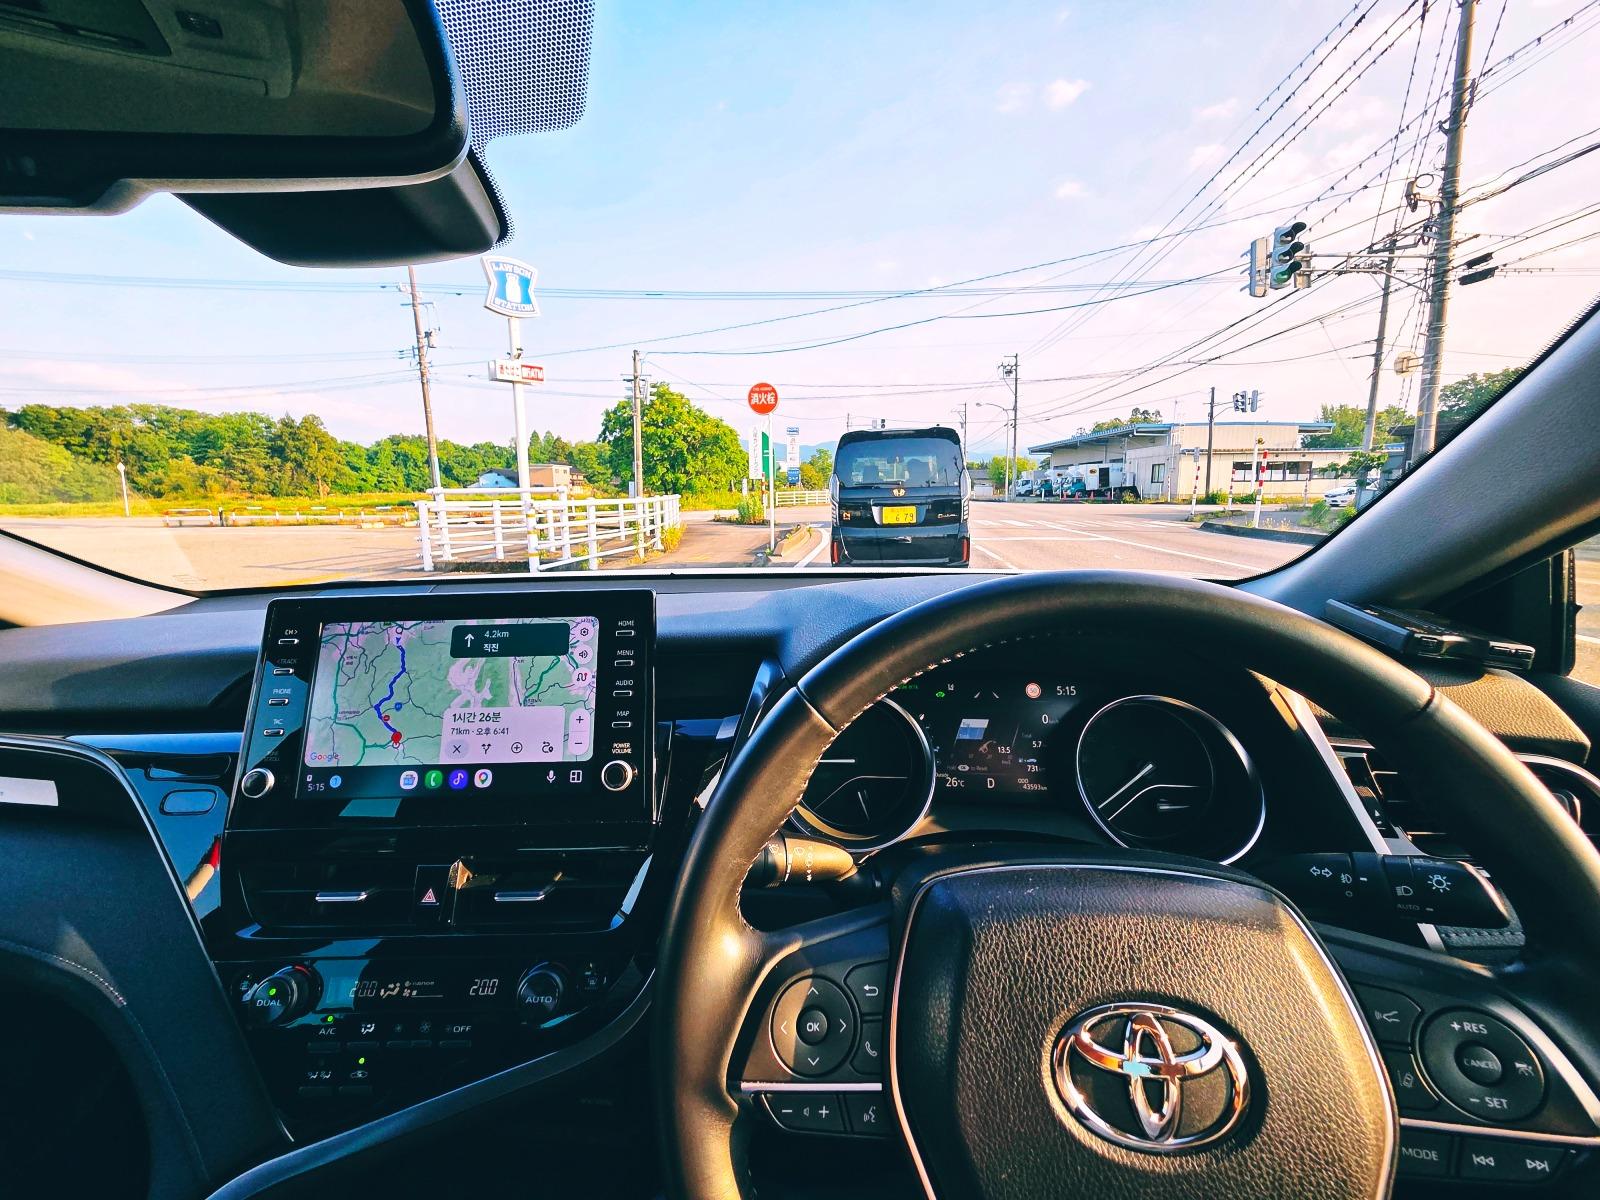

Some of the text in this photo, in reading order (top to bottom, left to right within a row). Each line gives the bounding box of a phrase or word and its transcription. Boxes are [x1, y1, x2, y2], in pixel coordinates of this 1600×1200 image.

[492, 262, 532, 279] LAWSON
[494, 297, 535, 312] STATION
[751, 391, 776, 405] 消火栓
[484, 630, 509, 639] 4.2km
[484, 642, 499, 653] 직진
[1056, 685, 1077, 696] 5:15
[452, 712, 502, 723] 1시간 26분
[450, 727, 509, 736] 71km 오후 6:41
[1032, 740, 1042, 748] 5.7
[997, 746, 1011, 754] 13.5
[310, 752, 340, 762] Google
[987, 778, 995, 788] D
[1397, 903, 1420, 911] AUTO
[256, 999, 282, 1007] DUAL
[525, 995, 552, 1004] AUTO
[318, 1027, 337, 1036] A/C
[453, 1025, 472, 1033] OFF
[806, 1022, 820, 1032] OK
[1463, 1057, 1499, 1070] CANCEL
[1401, 1147, 1439, 1162] MODE
